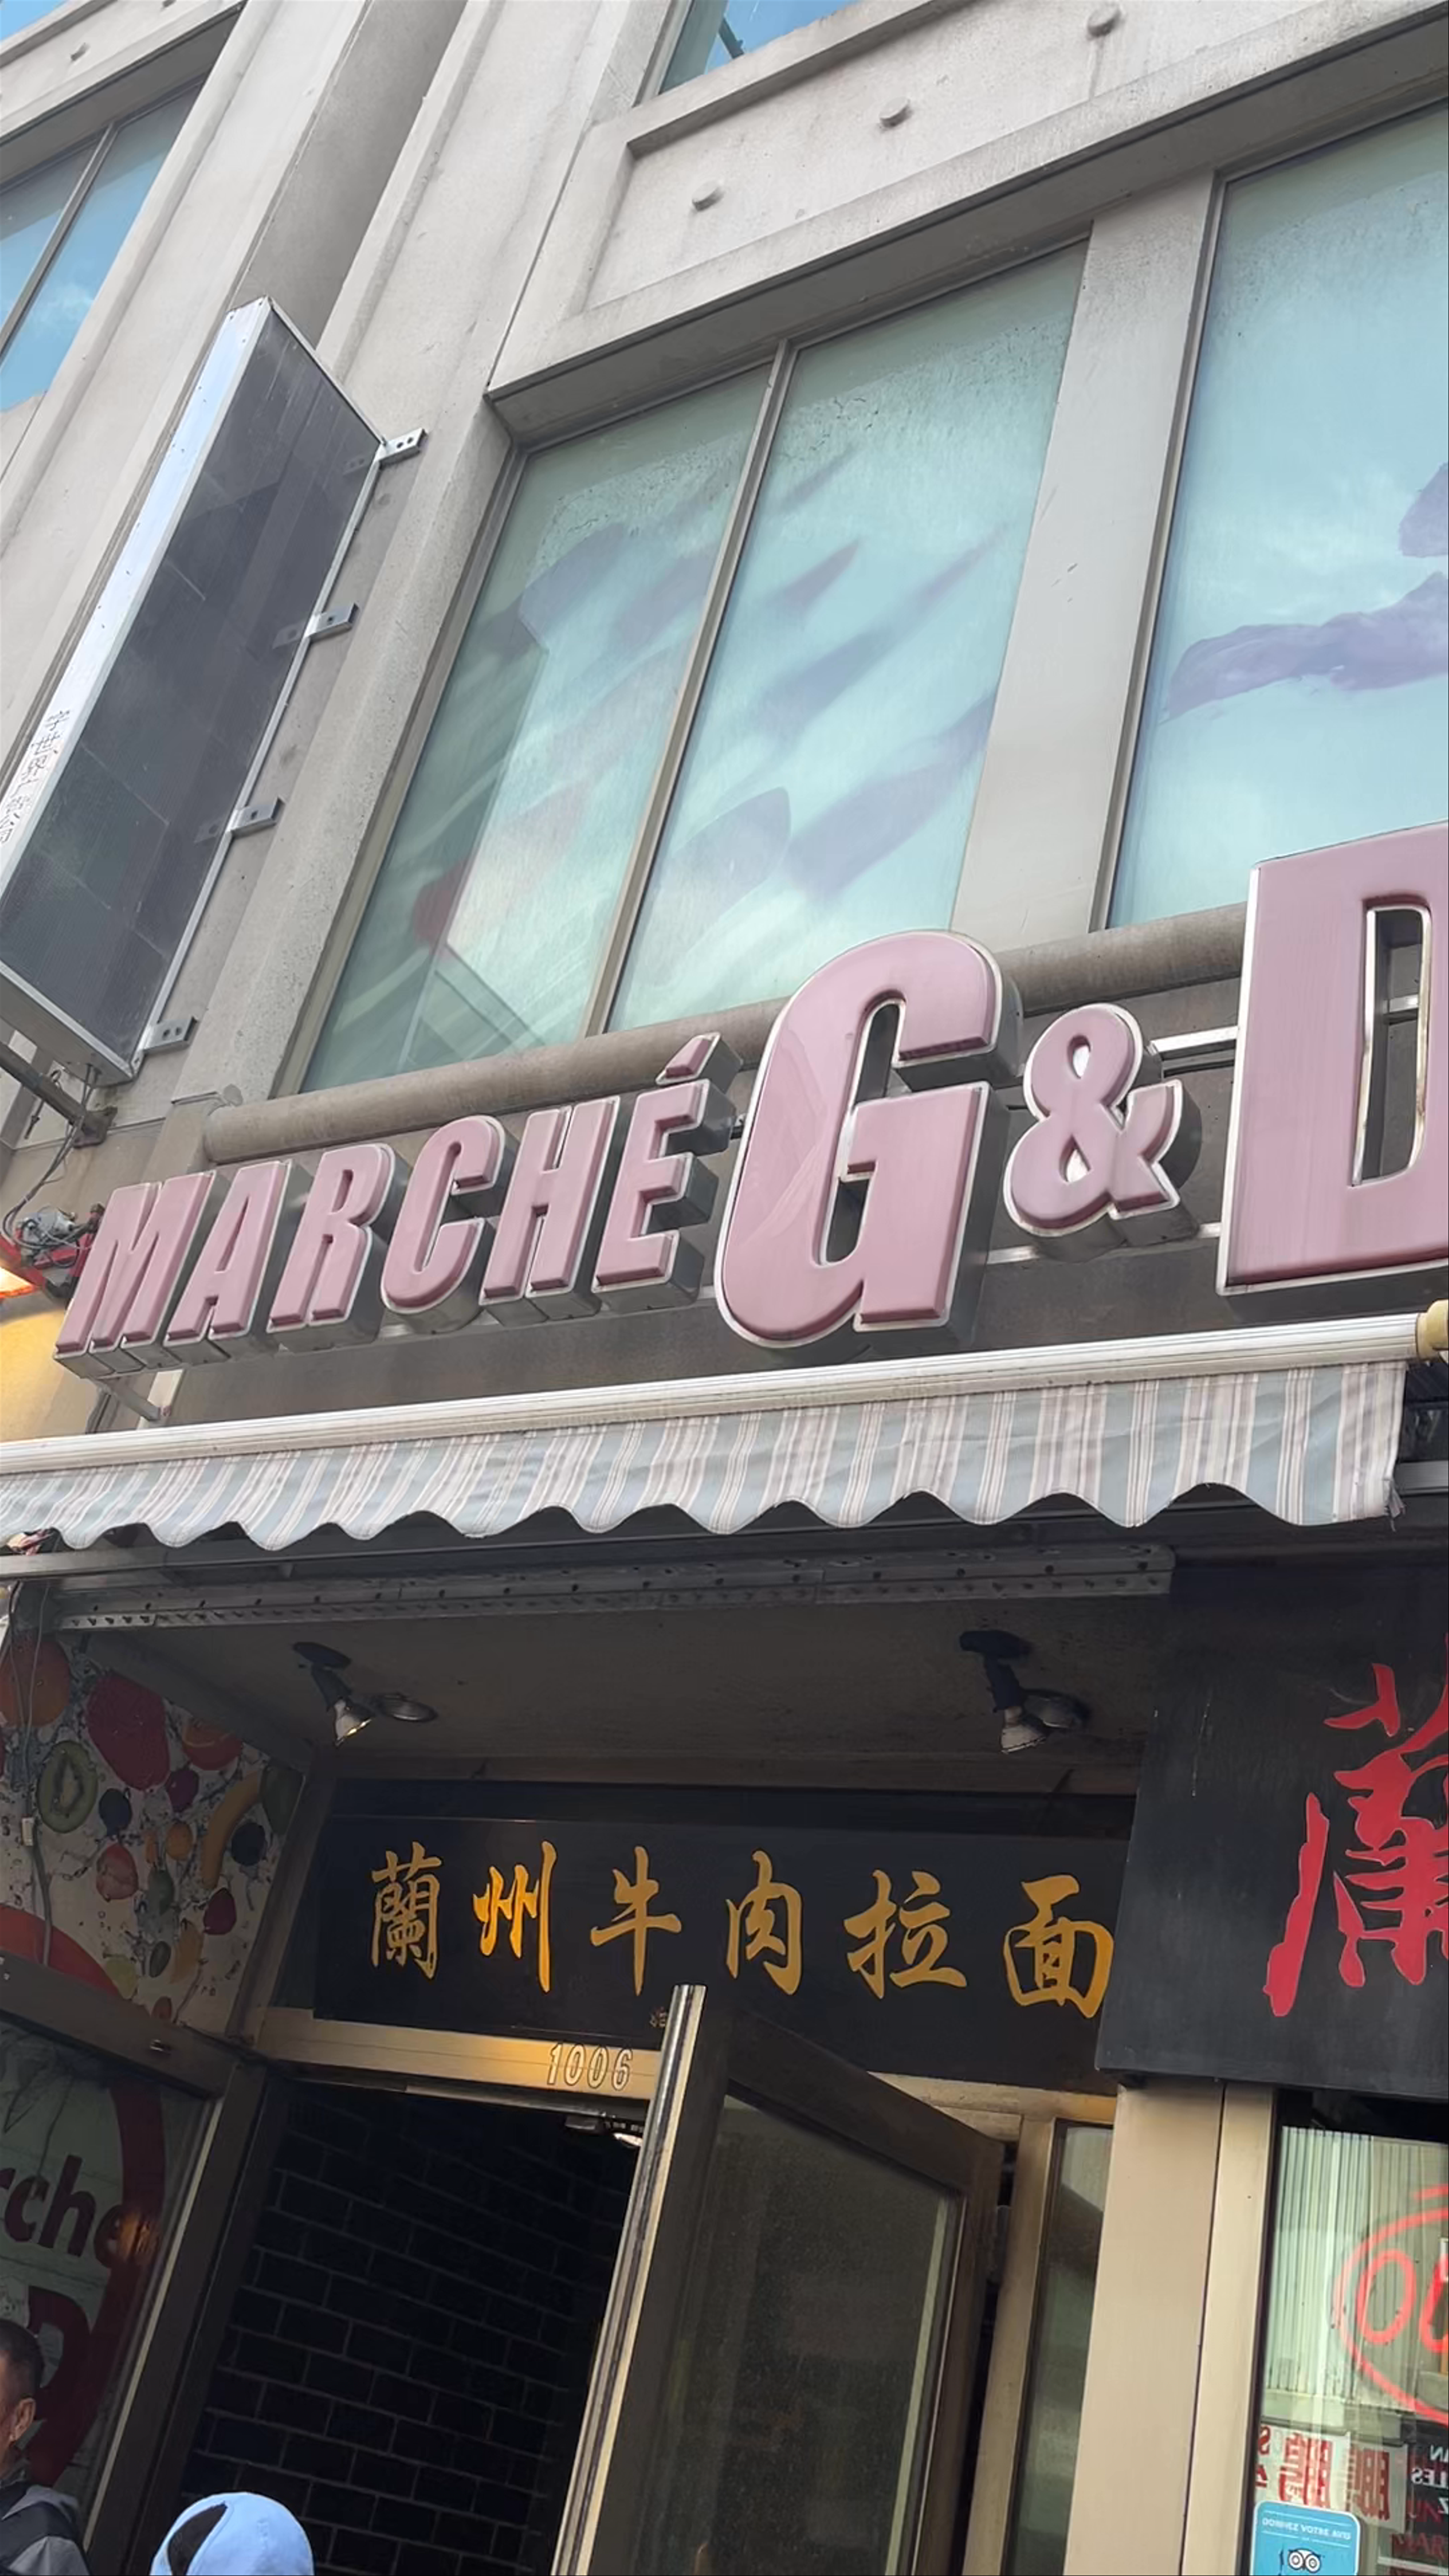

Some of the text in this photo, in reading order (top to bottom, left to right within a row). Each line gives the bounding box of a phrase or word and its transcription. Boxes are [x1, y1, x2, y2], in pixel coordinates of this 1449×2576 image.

[54, 1032, 721, 1360] MARCHÉ
[371, 1840, 1114, 2018] 蘭州牛肉拉面
[547, 2042, 633, 2091] 1006
